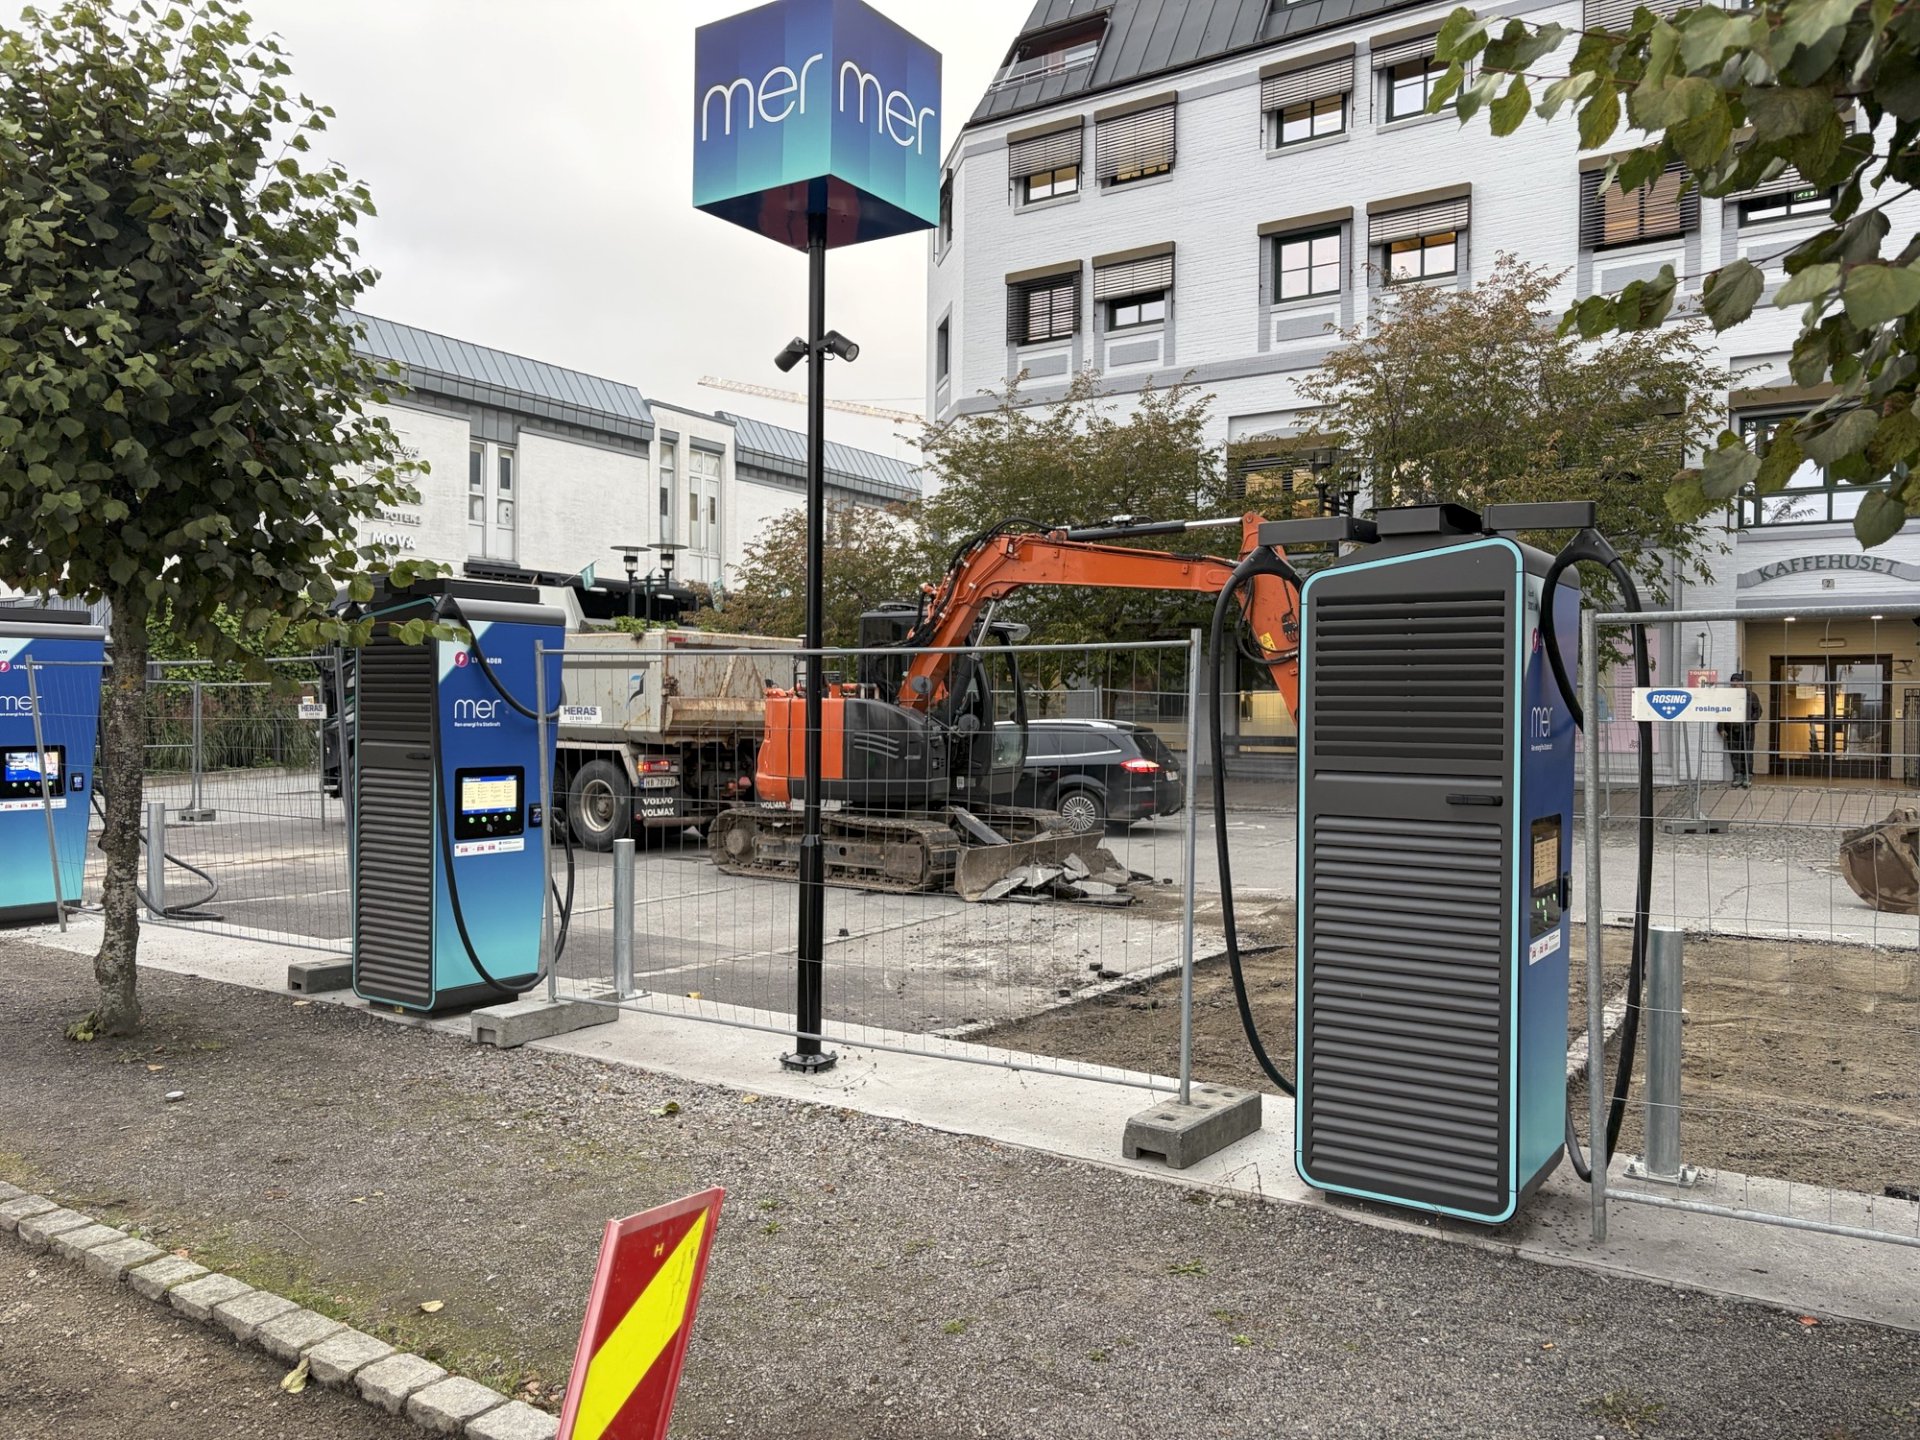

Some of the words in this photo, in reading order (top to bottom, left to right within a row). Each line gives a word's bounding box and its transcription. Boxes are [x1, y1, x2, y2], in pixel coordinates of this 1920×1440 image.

[702, 52, 823, 142] mer
[839, 60, 935, 155] mer
[1757, 554, 1901, 581] KAFFEHUSET
[1652, 694, 1688, 704] ROSING
[301, 704, 323, 712] HERAS
[454, 699, 502, 719] mer
[563, 706, 597, 716] HERAS
[1695, 705, 1732, 714] rosing.no
[1530, 706, 1553, 738] mer
[642, 797, 674, 805] VOLVO
[641, 807, 675, 817] VOLMAX
